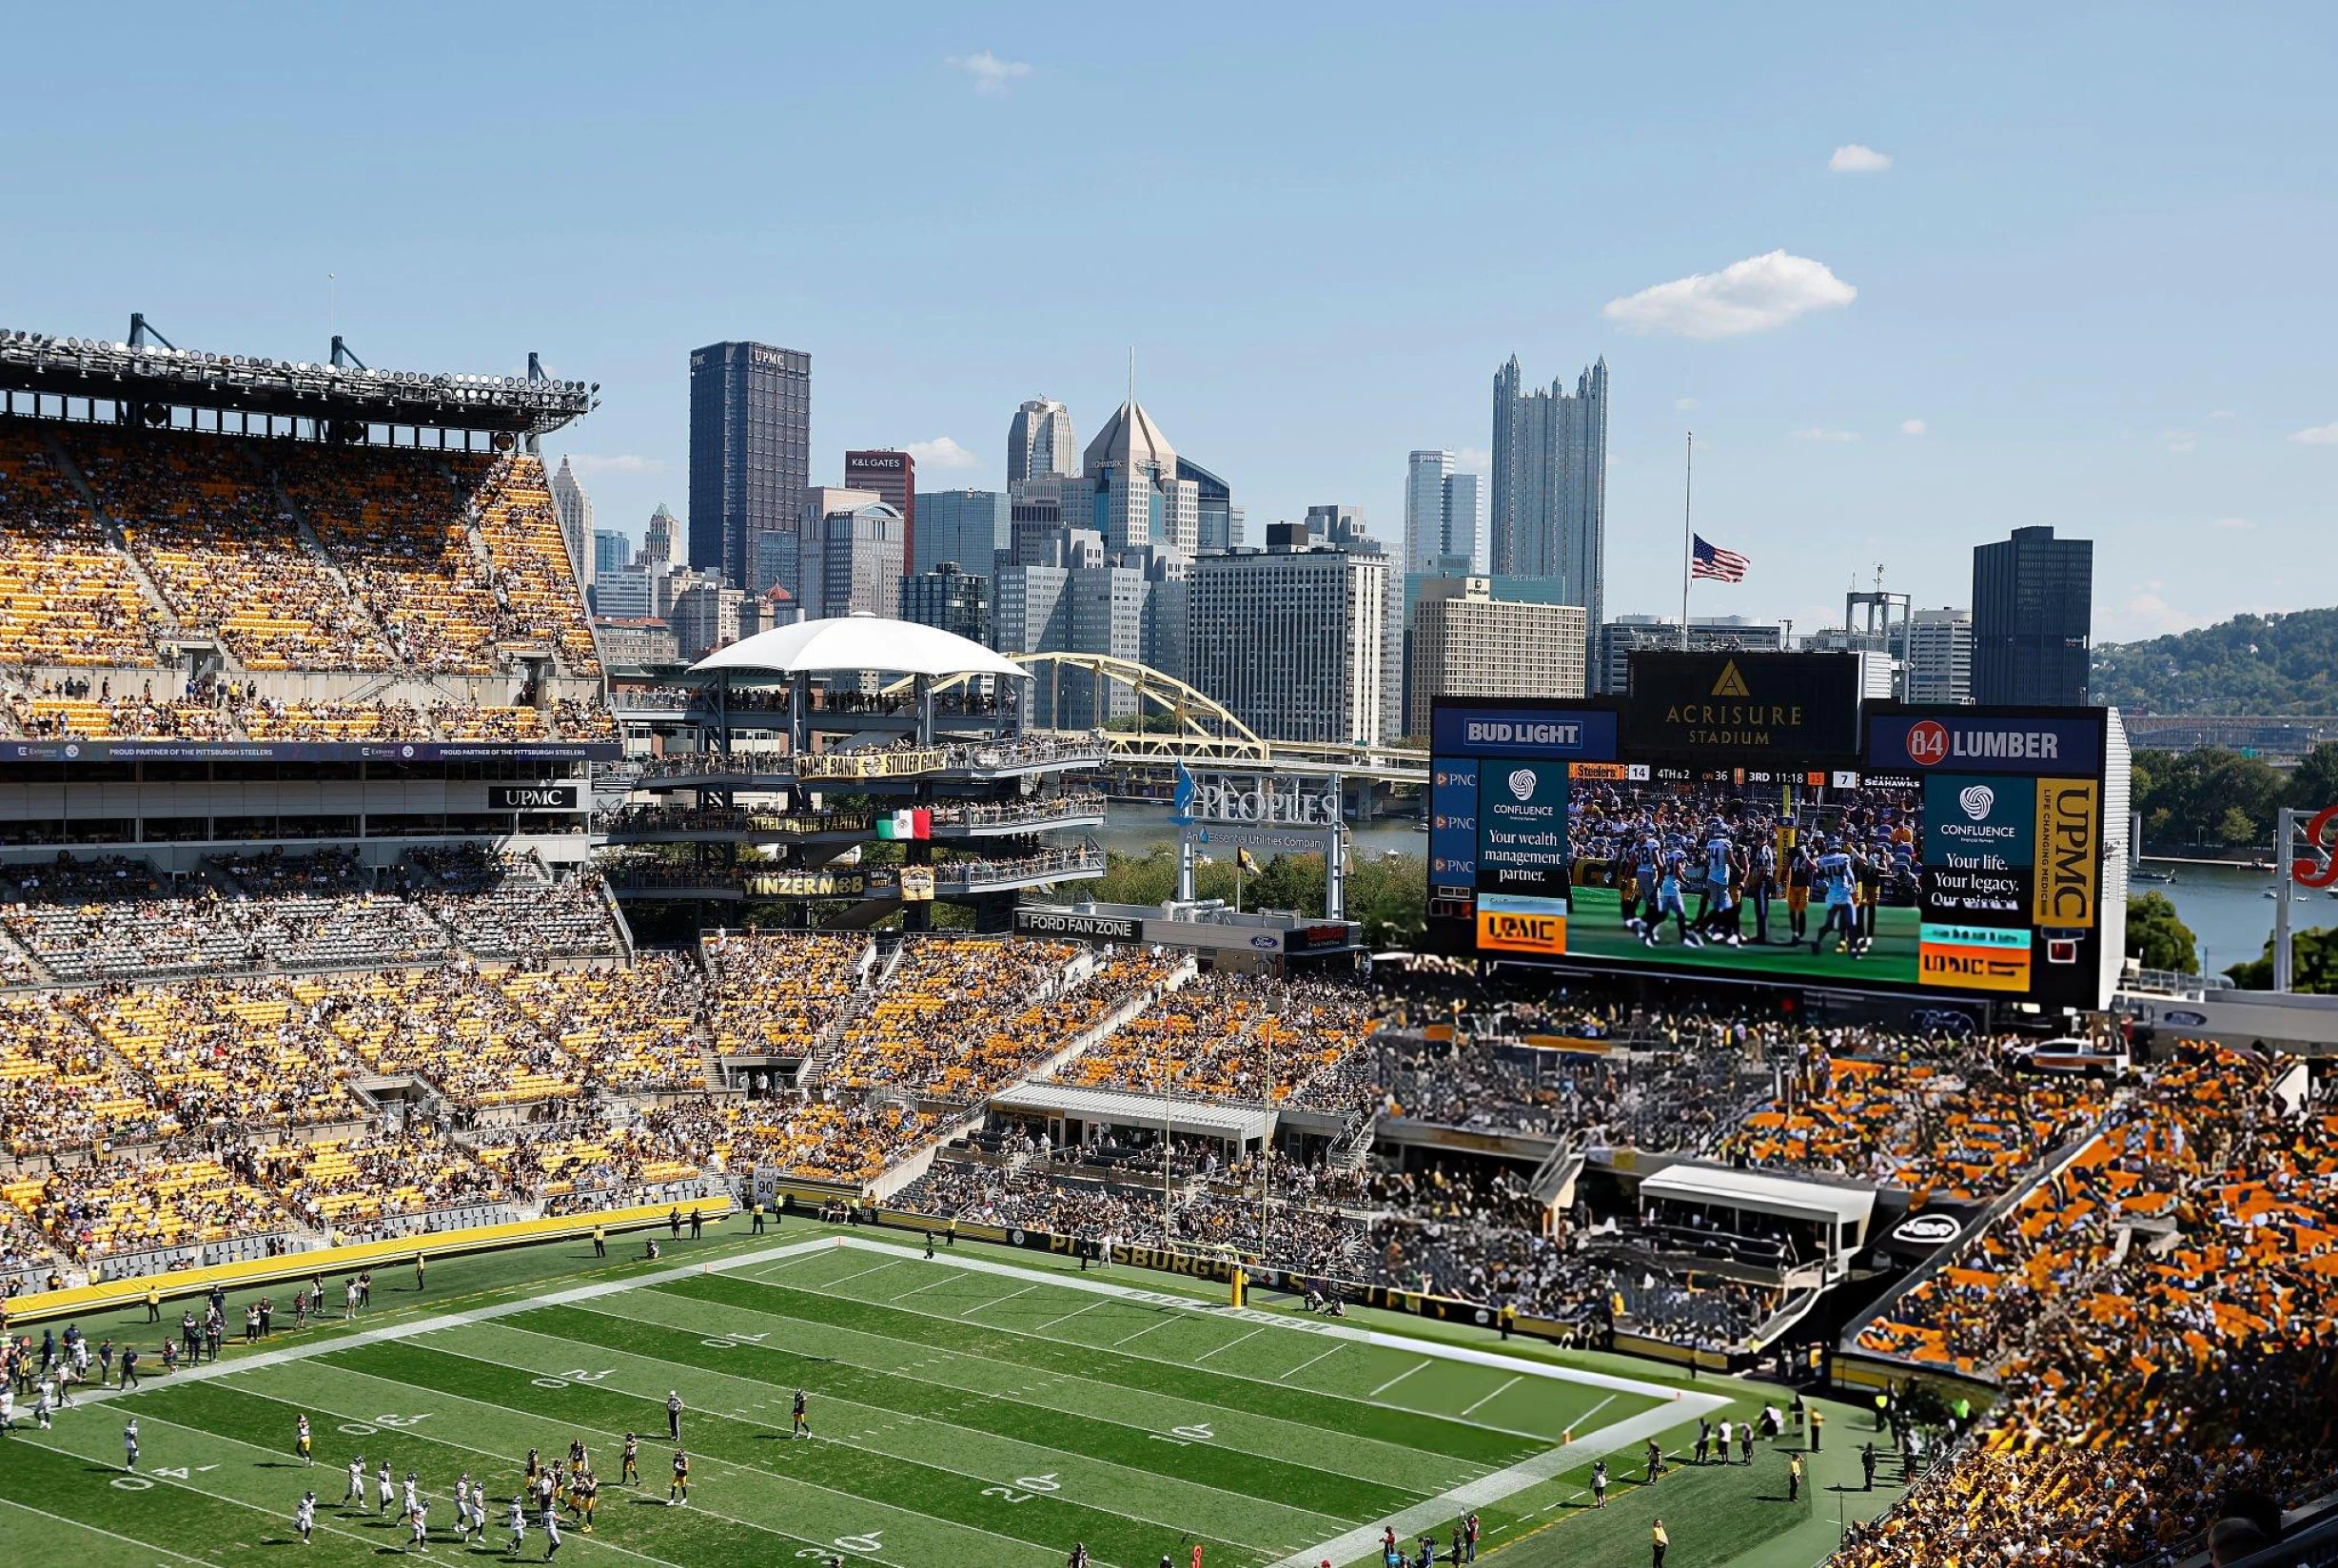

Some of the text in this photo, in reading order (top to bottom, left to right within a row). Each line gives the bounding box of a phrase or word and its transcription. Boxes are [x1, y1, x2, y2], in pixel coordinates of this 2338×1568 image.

[755, 349, 784, 366] UPMC
[852, 459, 900, 468] K&L GATES
[1665, 704, 1802, 726] ACRISURE
[1468, 722, 1579, 744] BUD LIGHT
[1688, 730, 1771, 745] STADIUM
[1911, 730, 2058, 758] 84 LUMBER
[109, 748, 273, 756] PROUD PARTNER OF THE PITTSBURGH STEELERS
[799, 755, 828, 777] BANG
[885, 753, 919, 774] STILLER
[1577, 765, 1617, 778] Steelers
[1632, 768, 1646, 777] 14
[1448, 773, 1476, 787] PNC
[1715, 771, 1728, 781] 36
[1748, 772, 1804, 784] 3RD 11:18
[1840, 774, 1848, 785] 7
[1864, 778, 1920, 789] SEAHAWKS
[505, 790, 563, 807] UPMC
[1195, 785, 1339, 826] PEOPLES
[1493, 804, 1554, 816] CONFLUENCE
[746, 813, 870, 833] STEEL PRIDE FAMILY
[1447, 816, 1475, 831] PNC
[1489, 830, 1558, 847] Your wealth
[1940, 824, 2015, 838] CONFLUENCE
[1187, 832, 1199, 841] An
[1209, 833, 1248, 844] Essential
[1285, 836, 1327, 850] Company
[1484, 850, 1562, 865] management
[2040, 789, 2052, 916] LIFE CHANGING MEDICI
[2053, 786, 2091, 918] UPMC
[1446, 859, 1475, 873] PNC
[1946, 853, 2009, 871] Your life.
[1499, 869, 1545, 883] partner.
[1935, 872, 2019, 893] Your legacy.
[1931, 892, 1959, 907] Our
[1030, 915, 1132, 937] FORD FAN ZONE
[1254, 936, 1275, 947] Ford
[758, 1181, 773, 1194] 90
[1050, 1235, 1233, 1279] PISBURGH
[1126, 1291, 1190, 1306] END
